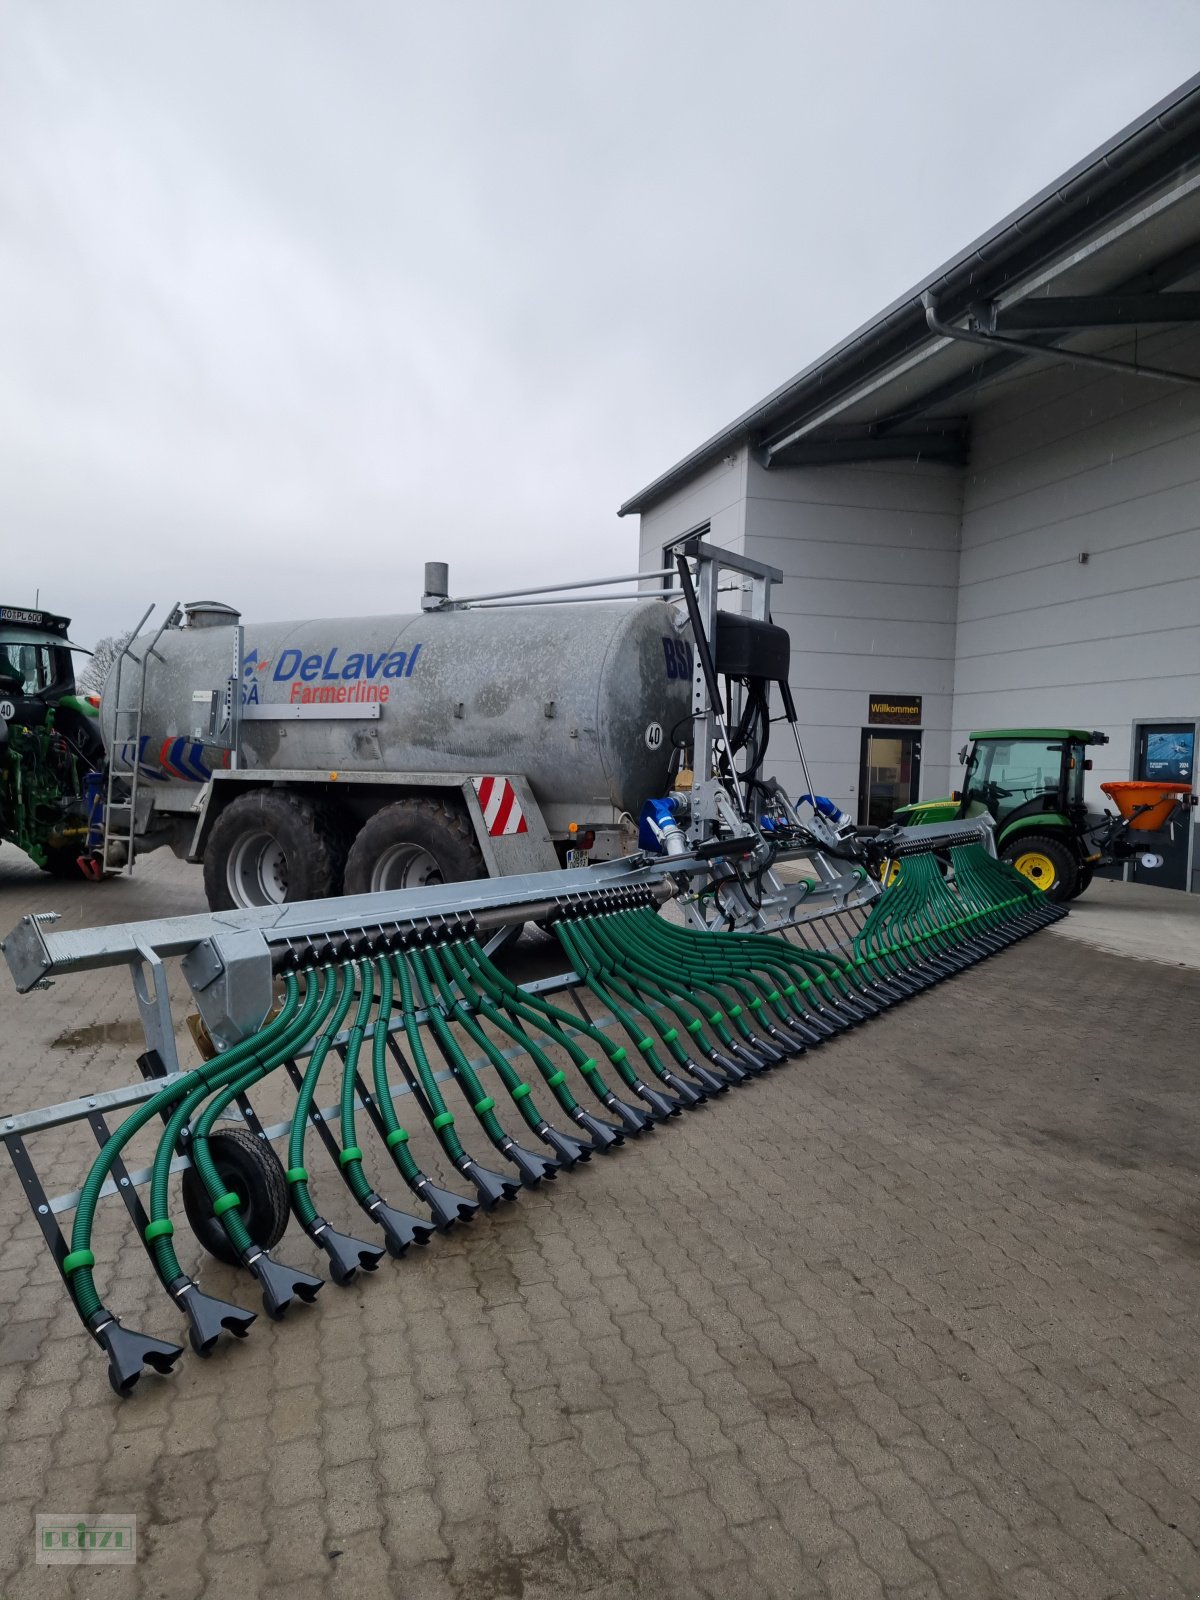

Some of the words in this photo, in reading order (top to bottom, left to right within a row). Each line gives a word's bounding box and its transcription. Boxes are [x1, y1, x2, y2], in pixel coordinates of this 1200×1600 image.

[1, 609, 12, 619] RO
[17, 611, 26, 621] PL
[273, 643, 422, 682] DeLaval
[290, 680, 390, 705] Farmerline
[1, 704, 12, 717] 40
[871, 703, 919, 714] Willkommen
[649, 727, 660, 745] 40
